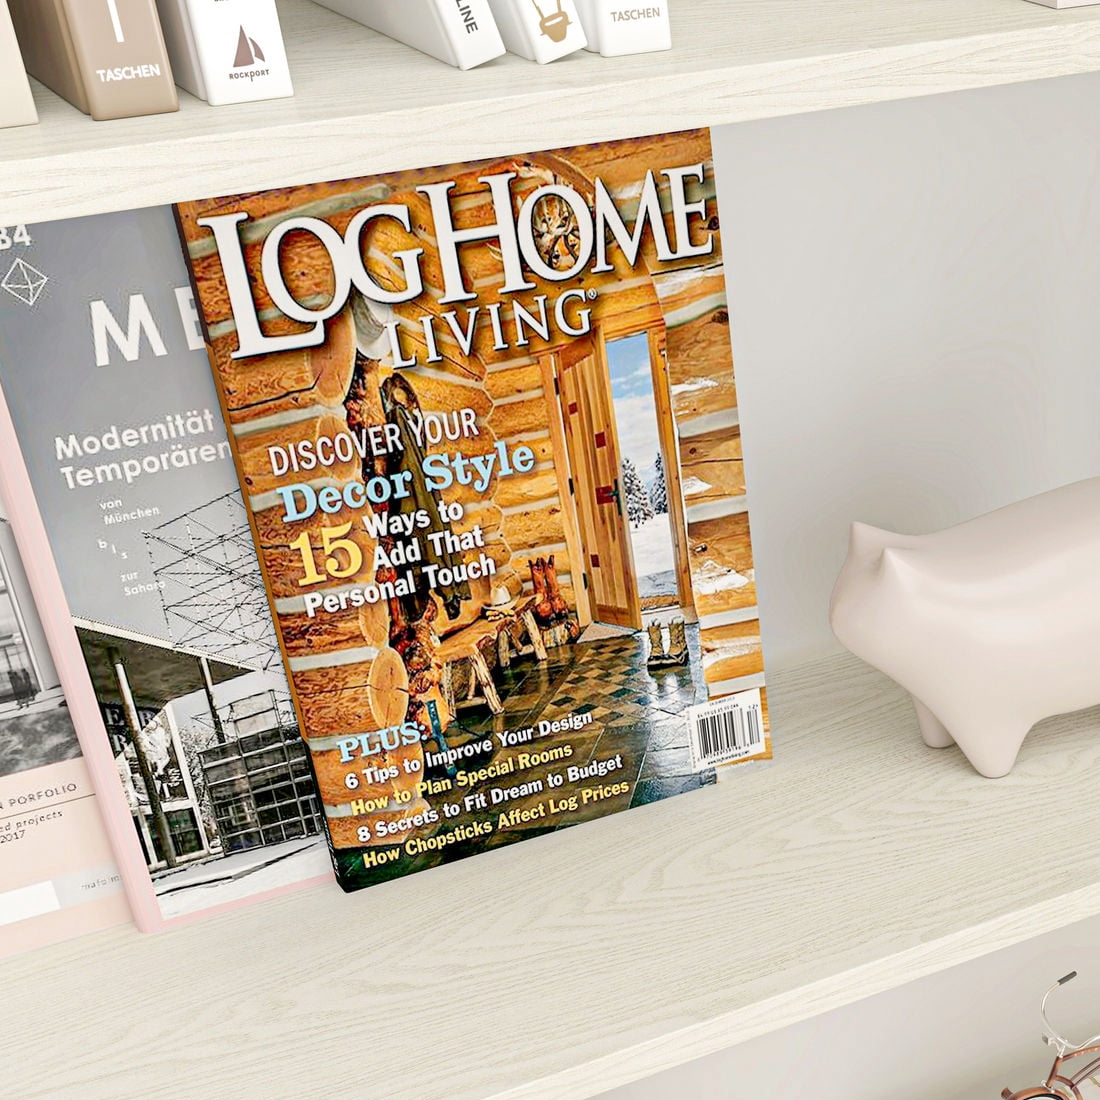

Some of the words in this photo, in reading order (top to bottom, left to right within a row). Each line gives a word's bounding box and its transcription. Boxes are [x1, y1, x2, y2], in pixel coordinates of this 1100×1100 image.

[611, 7, 661, 22] TASCHEN
[96, 63, 161, 82] TASCHEN
[229, 69, 270, 82] ROCKPORT
[54, 408, 215, 460] Modernität
[268, 423, 403, 476] DISCOVER
[407, 407, 480, 448] YOUR
[60, 440, 233, 489] Temporären
[277, 469, 413, 523] Decor
[421, 440, 535, 493] Style
[99, 498, 122, 511] von
[103, 504, 160, 526] München
[362, 507, 431, 539] Ways
[437, 500, 465, 522] to
[289, 521, 363, 587] 15
[373, 538, 422, 571] Add
[427, 525, 485, 558] That
[120, 571, 138, 583] zur
[124, 579, 166, 597] Sahara
[304, 567, 416, 618] Personal
[424, 554, 496, 589] Touch
[336, 721, 429, 763] PLUS:
[344, 773, 360, 789] 6
[361, 764, 399, 785] Tips
[403, 756, 421, 773] to
[424, 738, 493, 770] Improve
[496, 726, 535, 749] Your
[538, 711, 593, 737] Design
[9, 783, 77, 807] PORFOLIO
[350, 796, 388, 817] How
[394, 788, 412, 805] to
[415, 777, 452, 799] Plan
[455, 758, 515, 788] Special
[518, 743, 574, 770] Rooms
[356, 826, 371, 843] 8
[375, 808, 439, 836] Secrets
[442, 802, 461, 819] to
[463, 791, 487, 814] Fit
[490, 777, 543, 805] Dream
[546, 771, 564, 788] to
[566, 754, 623, 784] Budget
[16, 810, 63, 829] projects
[361, 847, 400, 869] How
[404, 818, 493, 857] Chopsticks
[497, 804, 547, 831] Affect
[548, 793, 578, 815] Log
[580, 781, 630, 806] Prices
